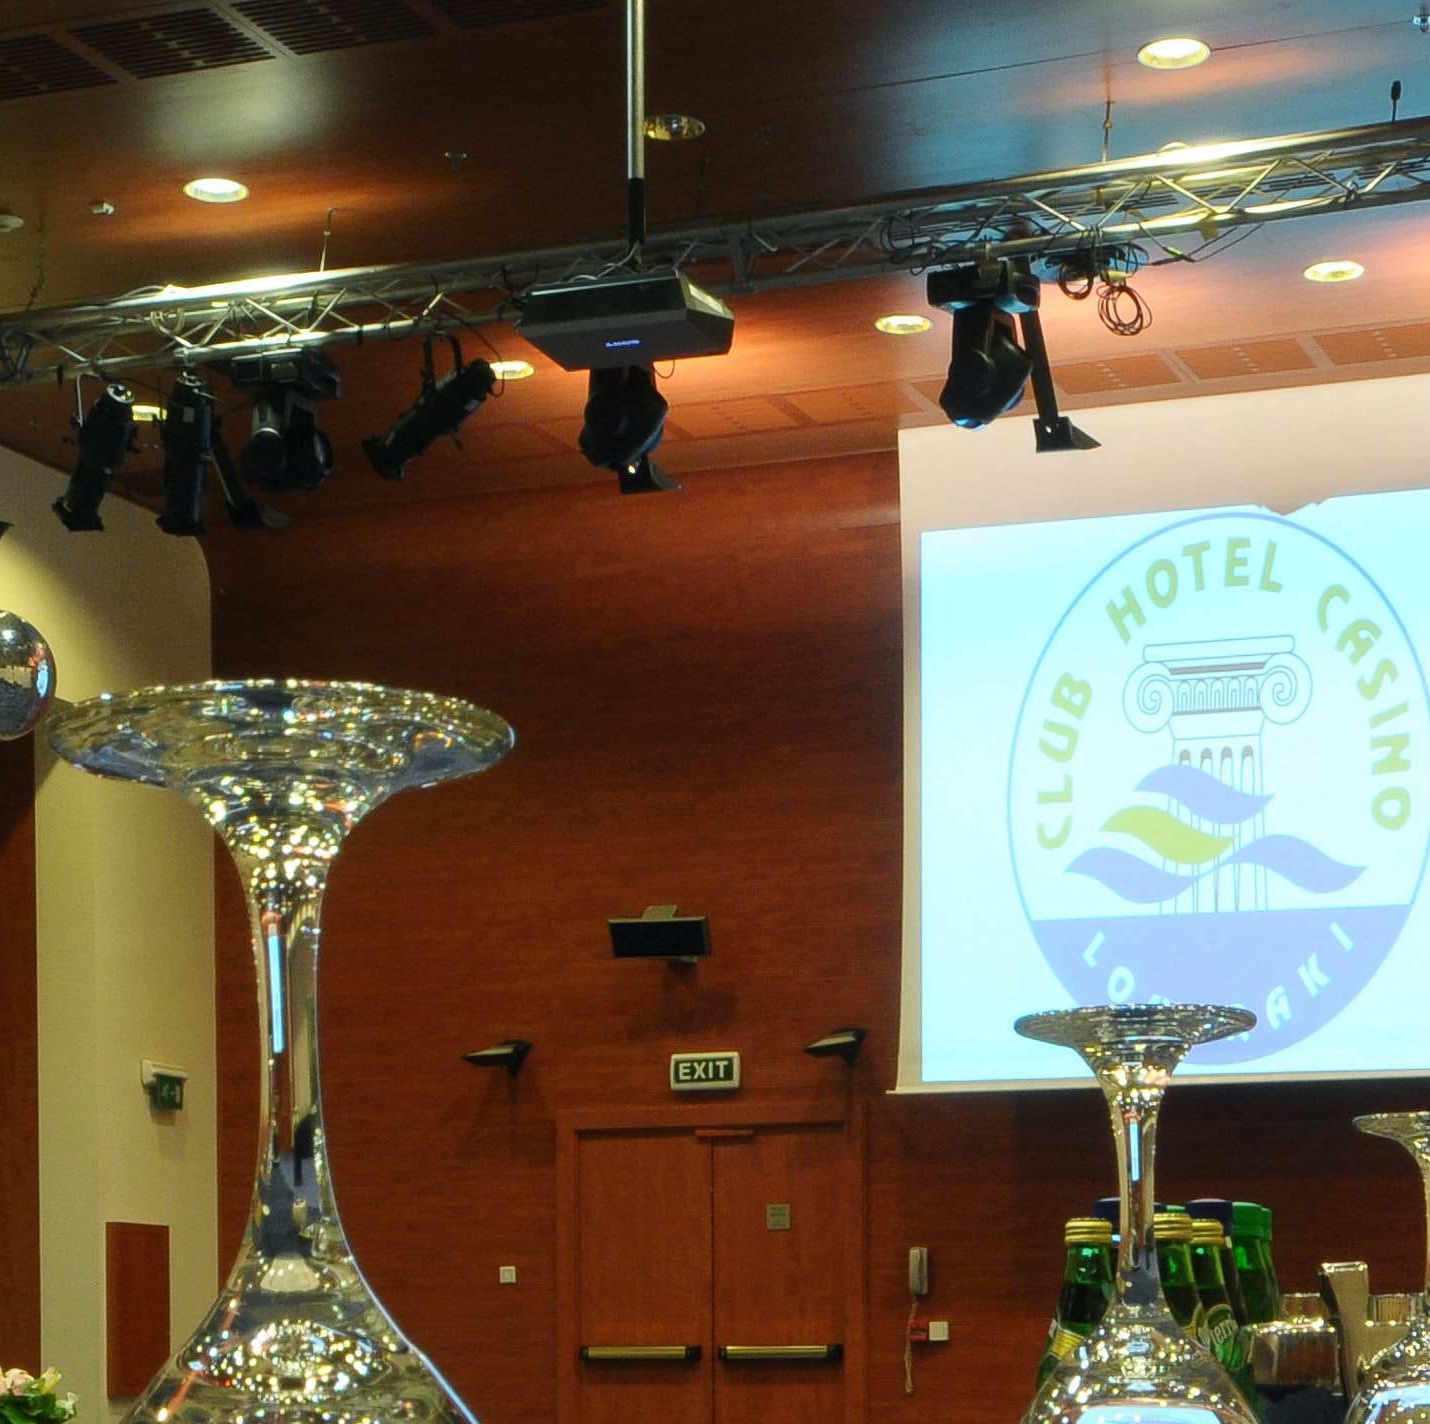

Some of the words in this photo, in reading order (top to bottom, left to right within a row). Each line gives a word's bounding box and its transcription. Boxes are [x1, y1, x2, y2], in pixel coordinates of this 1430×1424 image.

[1036, 670, 1093, 851] CLUB
[1104, 537, 1284, 645] HOTEL
[1316, 582, 1412, 831] CASINO
[678, 1060, 728, 1080] EXIT
